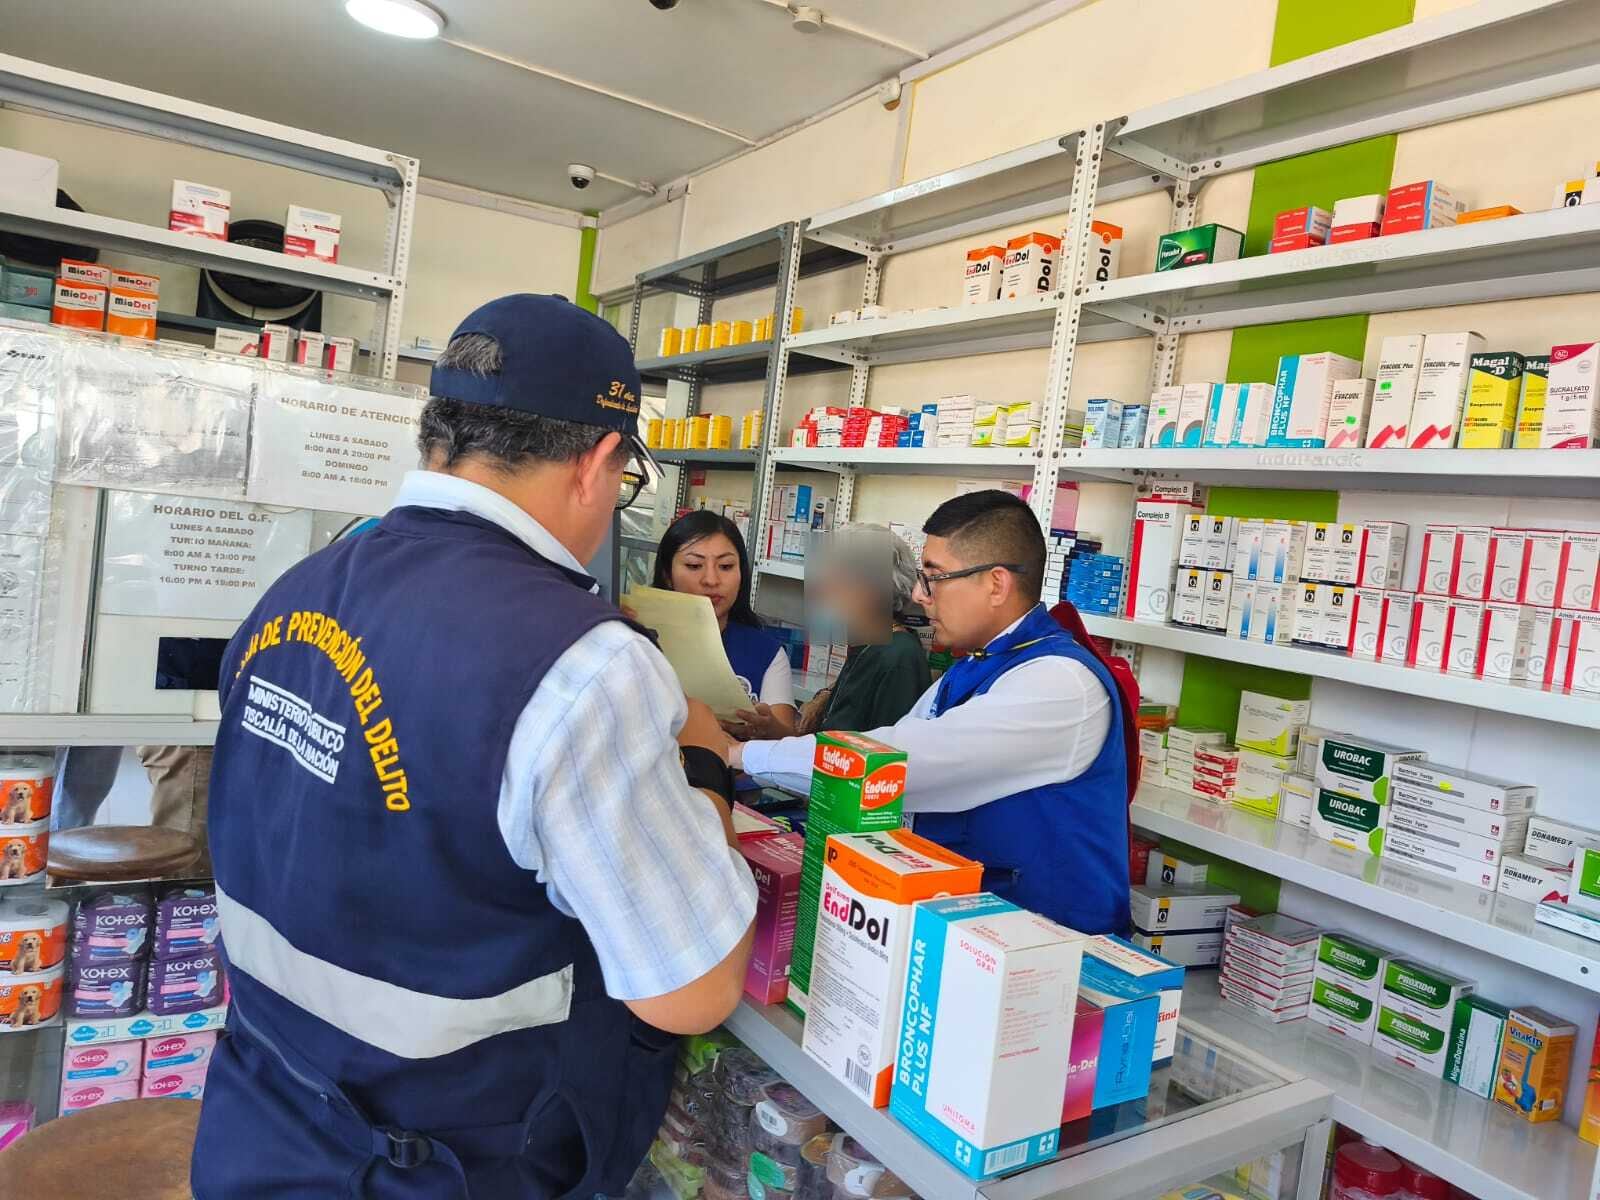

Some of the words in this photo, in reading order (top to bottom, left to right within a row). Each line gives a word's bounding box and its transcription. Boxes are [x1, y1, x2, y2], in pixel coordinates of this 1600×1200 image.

[1472, 356, 1509, 367] Magal
[608, 381, 626, 398] 31
[1550, 386, 1590, 394] SUCRALFATO
[281, 397, 337, 414] HORARIO
[341, 406, 357, 416] DE
[1270, 370, 1289, 436] BRONCOPHAR
[310, 432, 340, 442] LUNES
[352, 437, 389, 448] SABADO
[326, 447, 340, 455] AM
[325, 460, 368, 472] DOMINGO
[1154, 485, 1182, 495] Complejo
[1183, 485, 1188, 493] B
[153, 504, 215, 519] HORARIO
[219, 510, 244, 521] DEL
[1137, 510, 1163, 520] Complejo
[1164, 511, 1170, 519] B
[170, 523, 203, 532] LUNES
[215, 526, 254, 536] SABADO
[170, 536, 205, 545] TURNO
[187, 551, 202, 559] AM
[173, 563, 208, 572] TURNO
[188, 577, 203, 585] PM
[242, 580, 256, 588] PM
[259, 615, 284, 651] DE
[286, 611, 367, 683] PREVENCIÓN
[350, 666, 383, 725] DEL
[248, 683, 308, 728] MINISTERIO
[243, 705, 287, 740] FISCALÍA
[303, 743, 340, 777] NACIÓN
[364, 717, 411, 812] DELITO
[823, 745, 850, 775] EndGrip
[1334, 749, 1372, 766] UROBAC
[864, 779, 898, 797] EndGrip
[1329, 799, 1367, 816] UROBAC
[823, 890, 890, 947] EndDol
[1330, 947, 1367, 968] PROXIDOL
[1397, 973, 1438, 996] PROXIDOL
[1324, 989, 1359, 1010] PROXIDOL
[899, 938, 927, 1087] BRONCOPHAR
[920, 1001, 935, 1036] NF
[1391, 1017, 1430, 1041] PROXIDOL
[911, 1041, 930, 1097] PLUS
